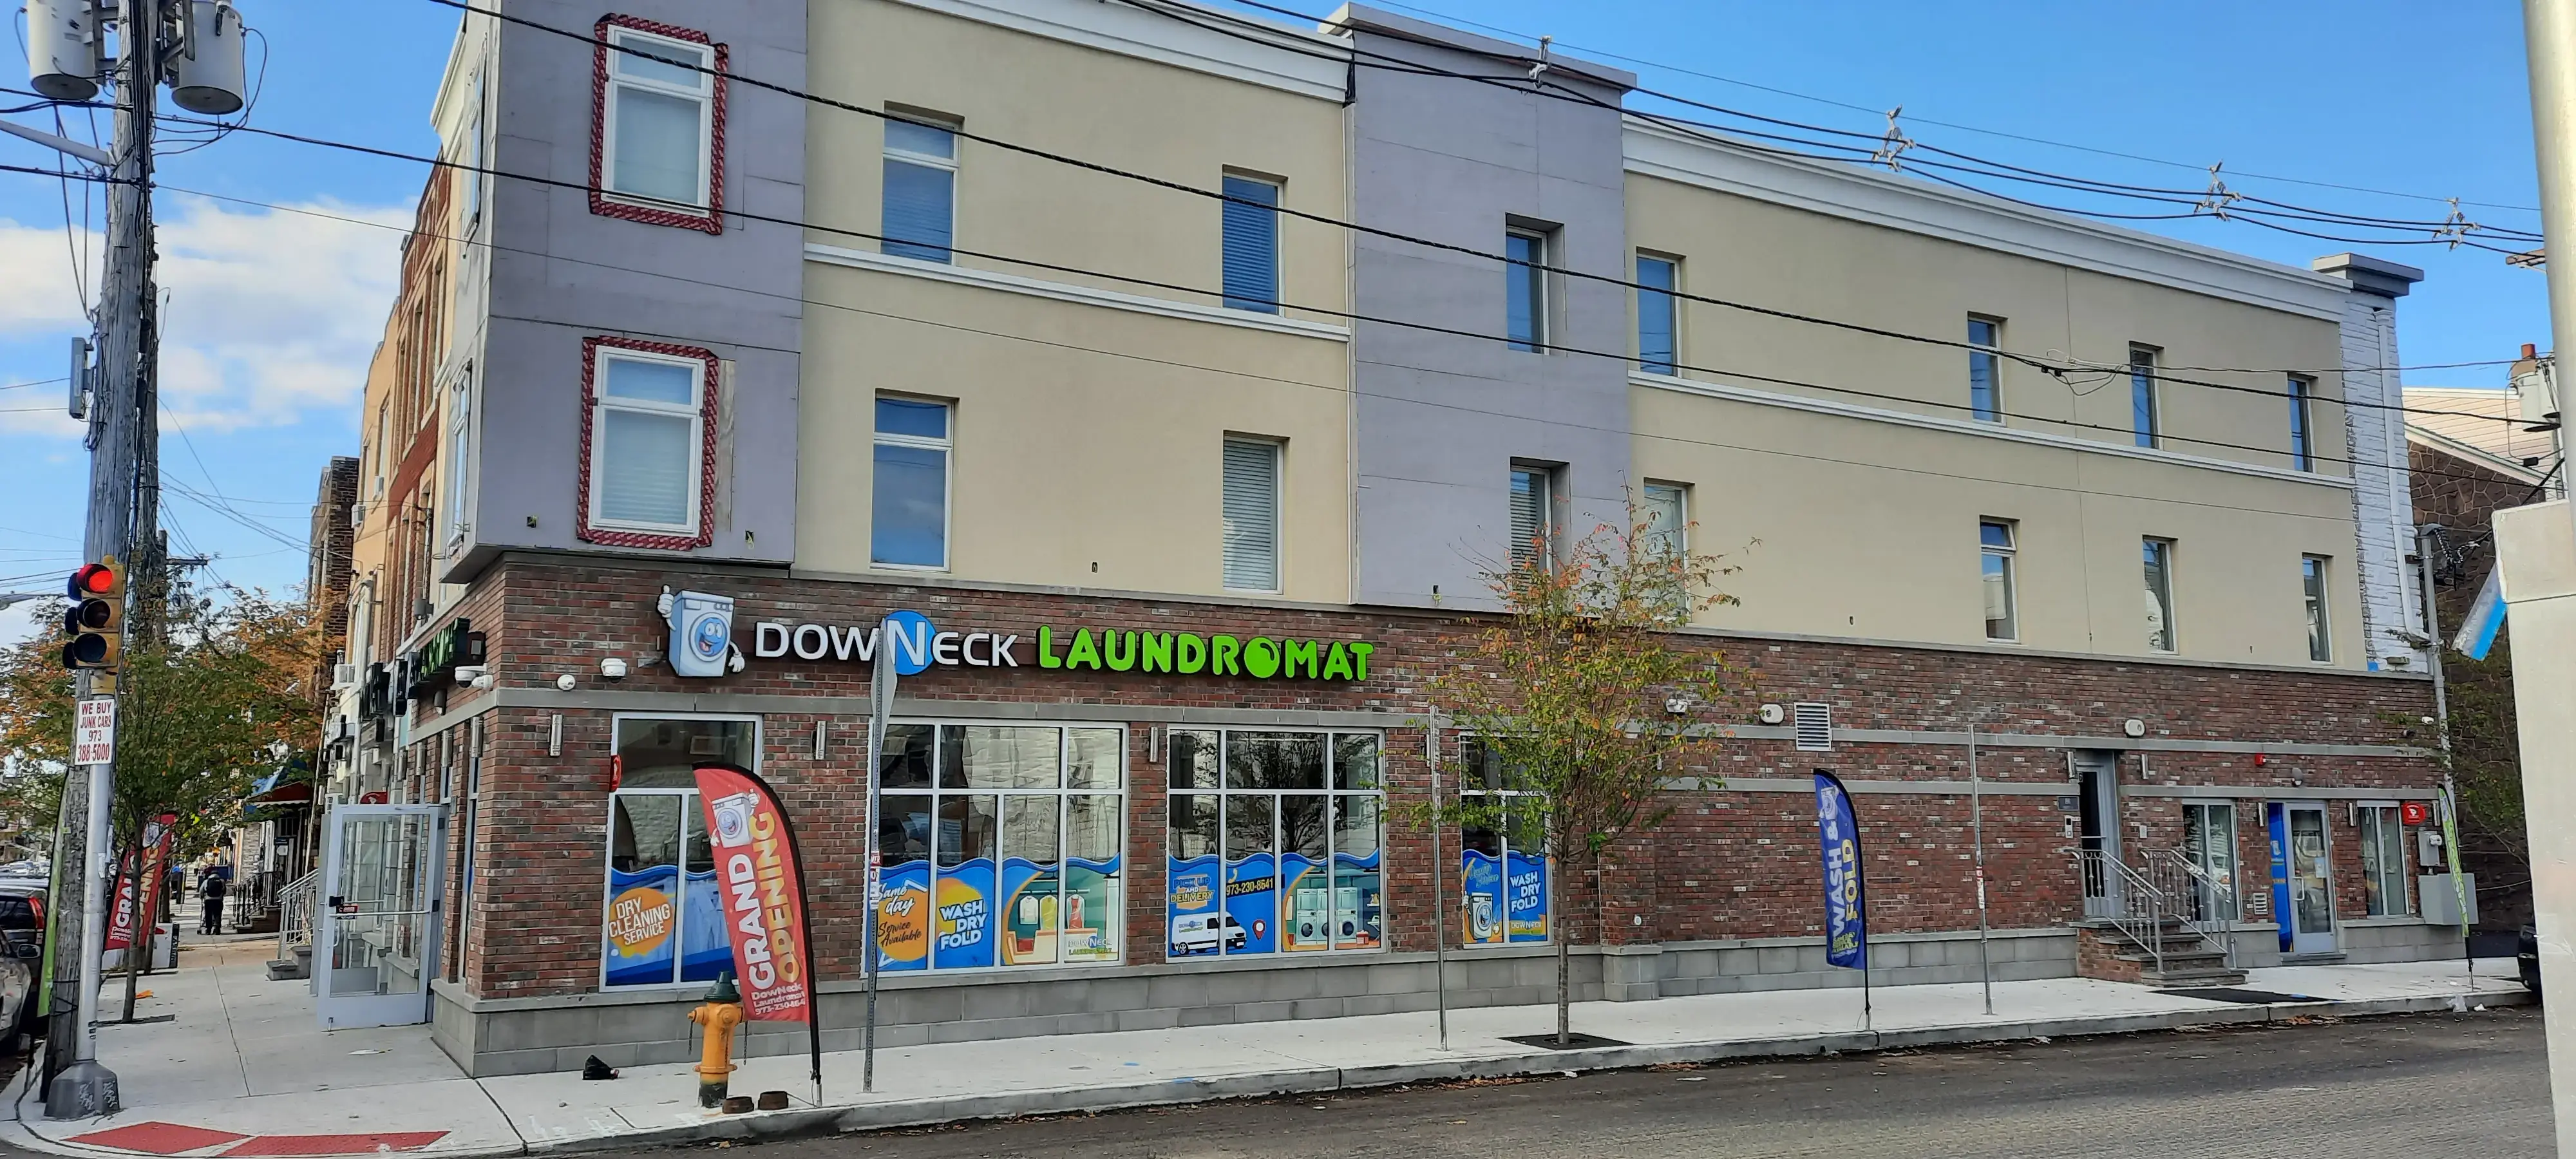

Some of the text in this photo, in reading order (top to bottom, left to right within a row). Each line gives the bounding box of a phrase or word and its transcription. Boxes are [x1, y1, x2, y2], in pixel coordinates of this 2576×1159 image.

[1037, 625, 1374, 681] LAUNDROMAT
[82, 702, 111, 715] WE BUY
[80, 715, 111, 728] JUNK CARS
[88, 730, 102, 742] 973
[77, 743, 110, 762] 388-5000
[1827, 820, 1839, 841] &
[1174, 876, 1211, 889] PICK UP
[1226, 878, 1273, 896] 973-230-8641
[1510, 871, 1538, 888] WASH
[1520, 882, 1540, 898] DRY
[1842, 839, 1858, 921] FOLD
[749, 811, 800, 983] OPENING
[1170, 890, 1214, 903] DELIVERY
[1828, 847, 1845, 938] WASH
[616, 897, 642, 919] DRY
[885, 896, 916, 917] day
[939, 899, 983, 921] WASH
[1510, 896, 1538, 912] FOLD
[609, 903, 670, 938] CLEANING
[727, 853, 776, 990] GRAND
[878, 921, 911, 937] Service
[955, 912, 989, 933] DRY
[624, 920, 665, 946] SERVICE
[880, 929, 922, 947] Available
[940, 928, 983, 952] FOLD
